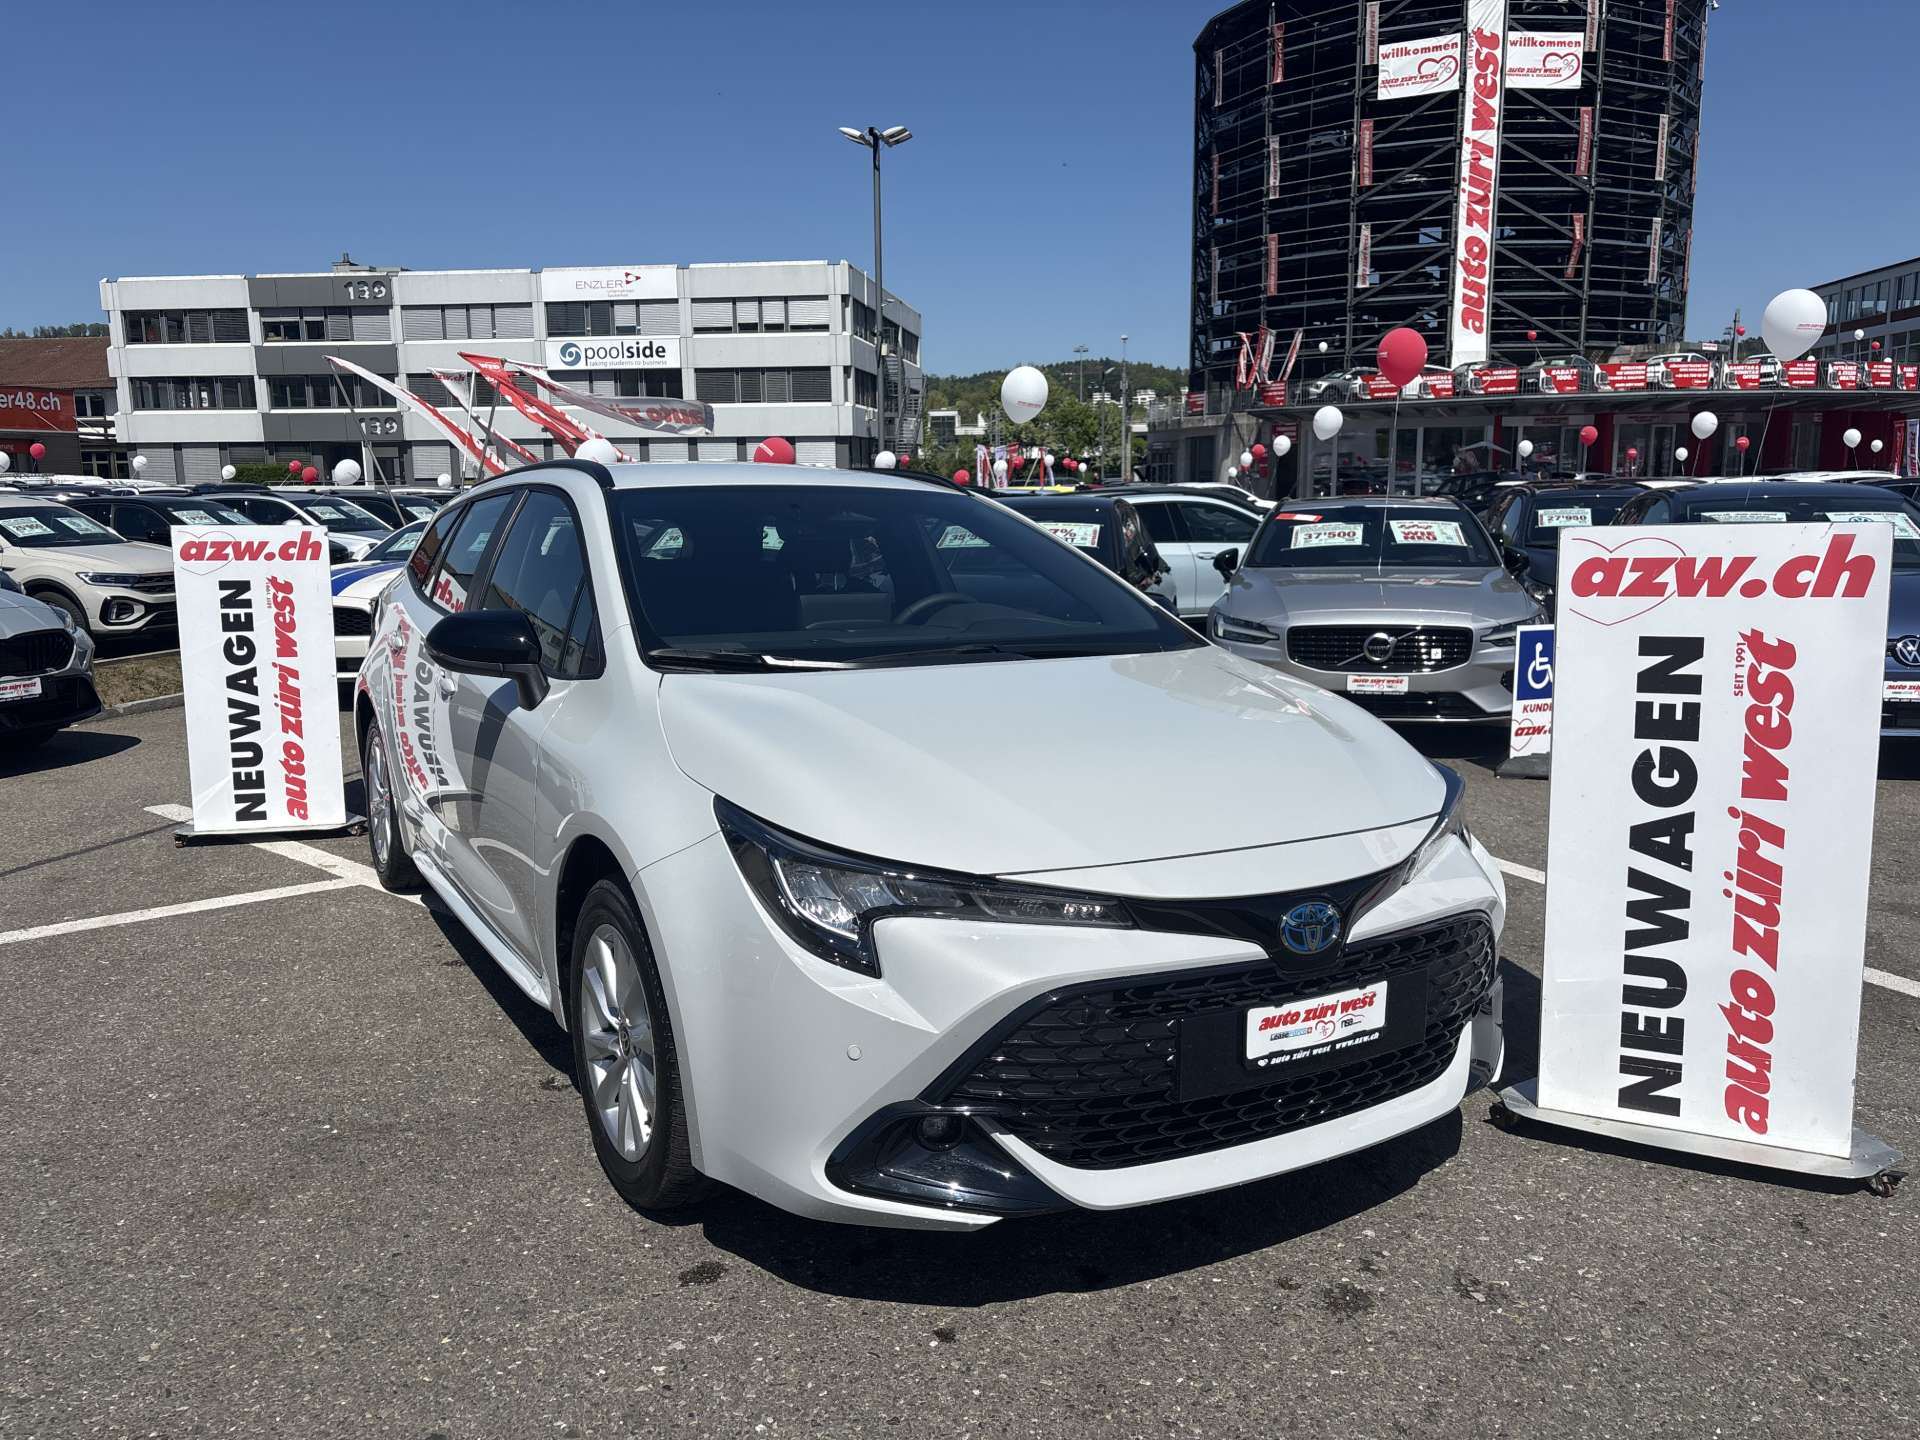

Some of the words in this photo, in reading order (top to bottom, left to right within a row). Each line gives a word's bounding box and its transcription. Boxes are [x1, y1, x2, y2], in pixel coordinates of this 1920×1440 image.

[1381, 42, 1459, 60] willkommen
[1509, 36, 1582, 48] willkommen
[1472, 27, 1500, 131] west
[1461, 137, 1495, 234] züri
[575, 280, 624, 290] ENZLER
[1458, 236, 1488, 335] auto
[584, 341, 666, 366] poolside
[180, 531, 323, 562] azw.ch
[1303, 530, 1357, 540] 37'500
[1570, 533, 1876, 599] azw.ch
[266, 575, 296, 658] west
[1733, 673, 1744, 697] SEIT
[1735, 642, 1747, 672] 1991
[219, 579, 267, 822] NEUWAGEN
[272, 662, 304, 740] züri
[1514, 725, 1552, 737] azw.
[1738, 628, 1797, 801] west
[280, 740, 309, 821] auto
[1617, 635, 1705, 1117] NEUWAGEN
[1722, 806, 1786, 972] züri
[1258, 1009, 1301, 1032] auto
[1301, 999, 1340, 1024] züri
[1340, 991, 1377, 1014] west
[1270, 1055, 1290, 1065] auto
[1312, 1044, 1332, 1056] west
[1717, 969, 1777, 1136] auto
